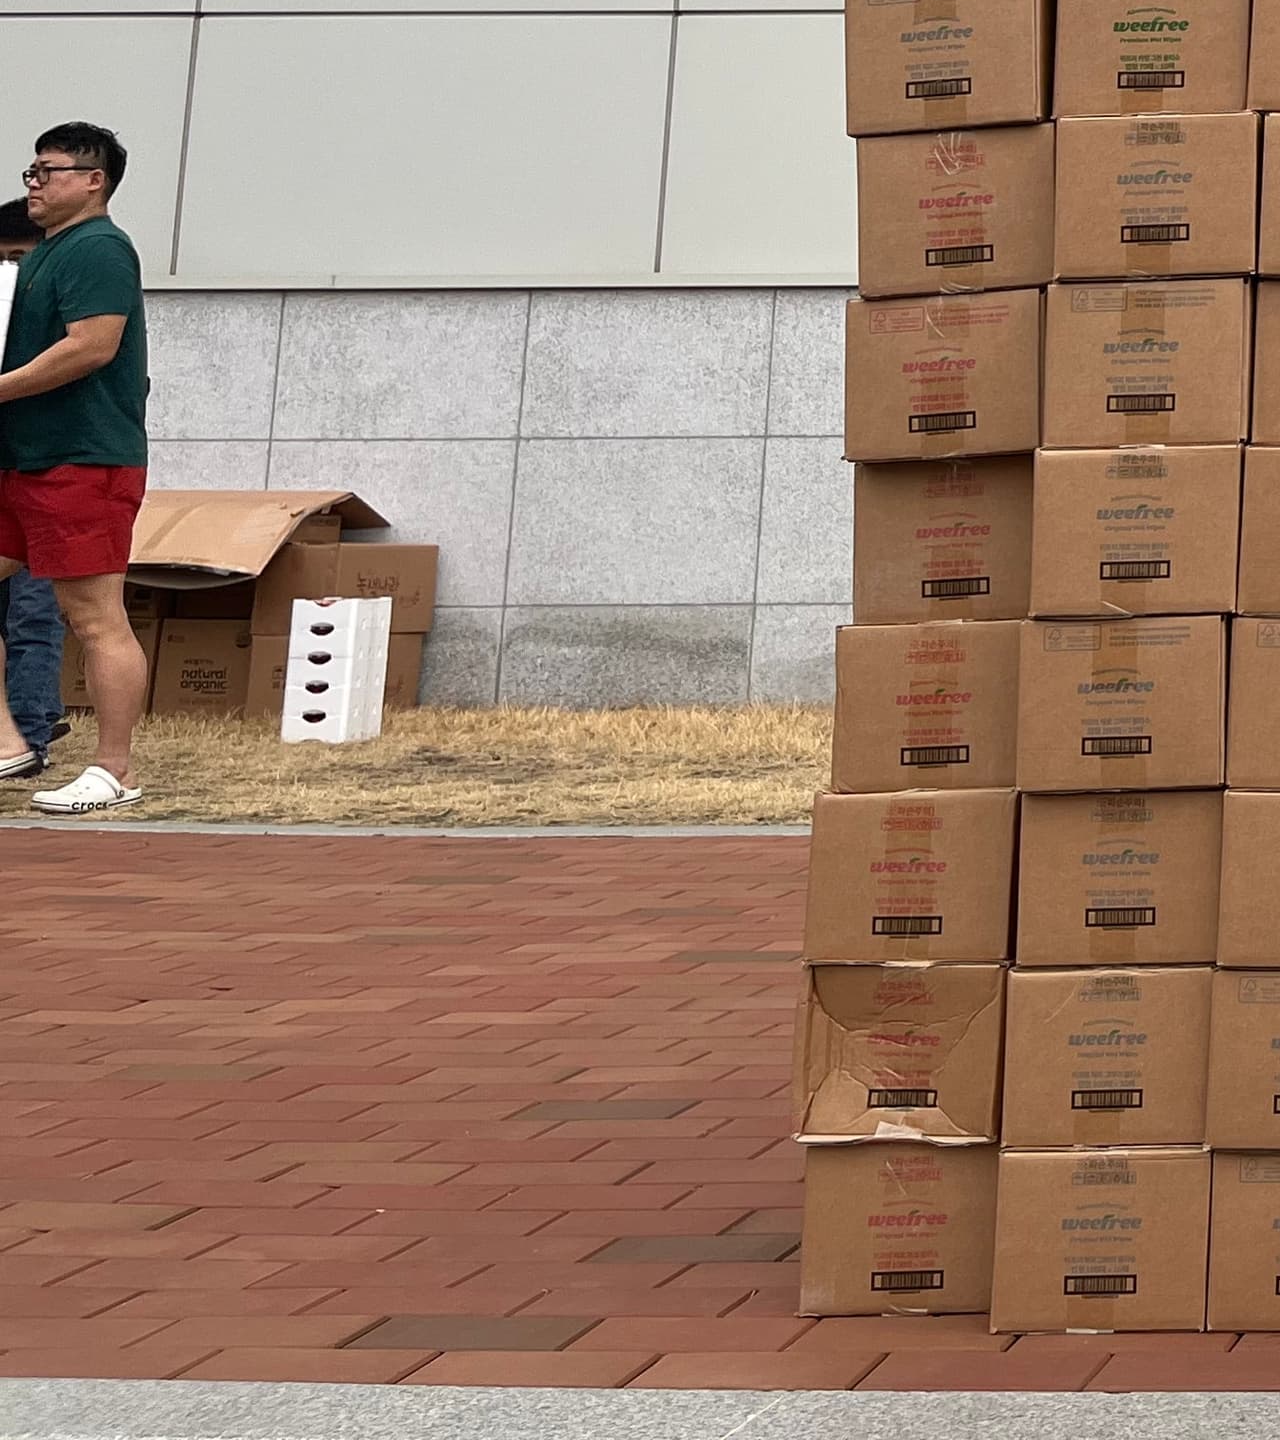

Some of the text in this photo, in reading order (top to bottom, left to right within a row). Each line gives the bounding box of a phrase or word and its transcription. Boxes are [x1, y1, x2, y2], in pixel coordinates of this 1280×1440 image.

[1113, 17, 1189, 32] weefree
[901, 26, 973, 41] weefree
[1117, 169, 1192, 186] weefree
[919, 192, 996, 208] weefree
[1103, 338, 1179, 353] weefree
[903, 357, 975, 373] weefree
[1097, 504, 1174, 521] weefree
[916, 523, 990, 539] weefree
[181, 667, 227, 679] natural
[180, 680, 229, 692] organic
[1078, 678, 1154, 695] weefree
[896, 689, 971, 707] weefree
[870, 857, 946, 874] weefree
[1082, 849, 1159, 866] weefree
[1069, 1030, 1147, 1047] weefree
[868, 1210, 947, 1229] weefree
[1062, 1214, 1142, 1232] weefree
